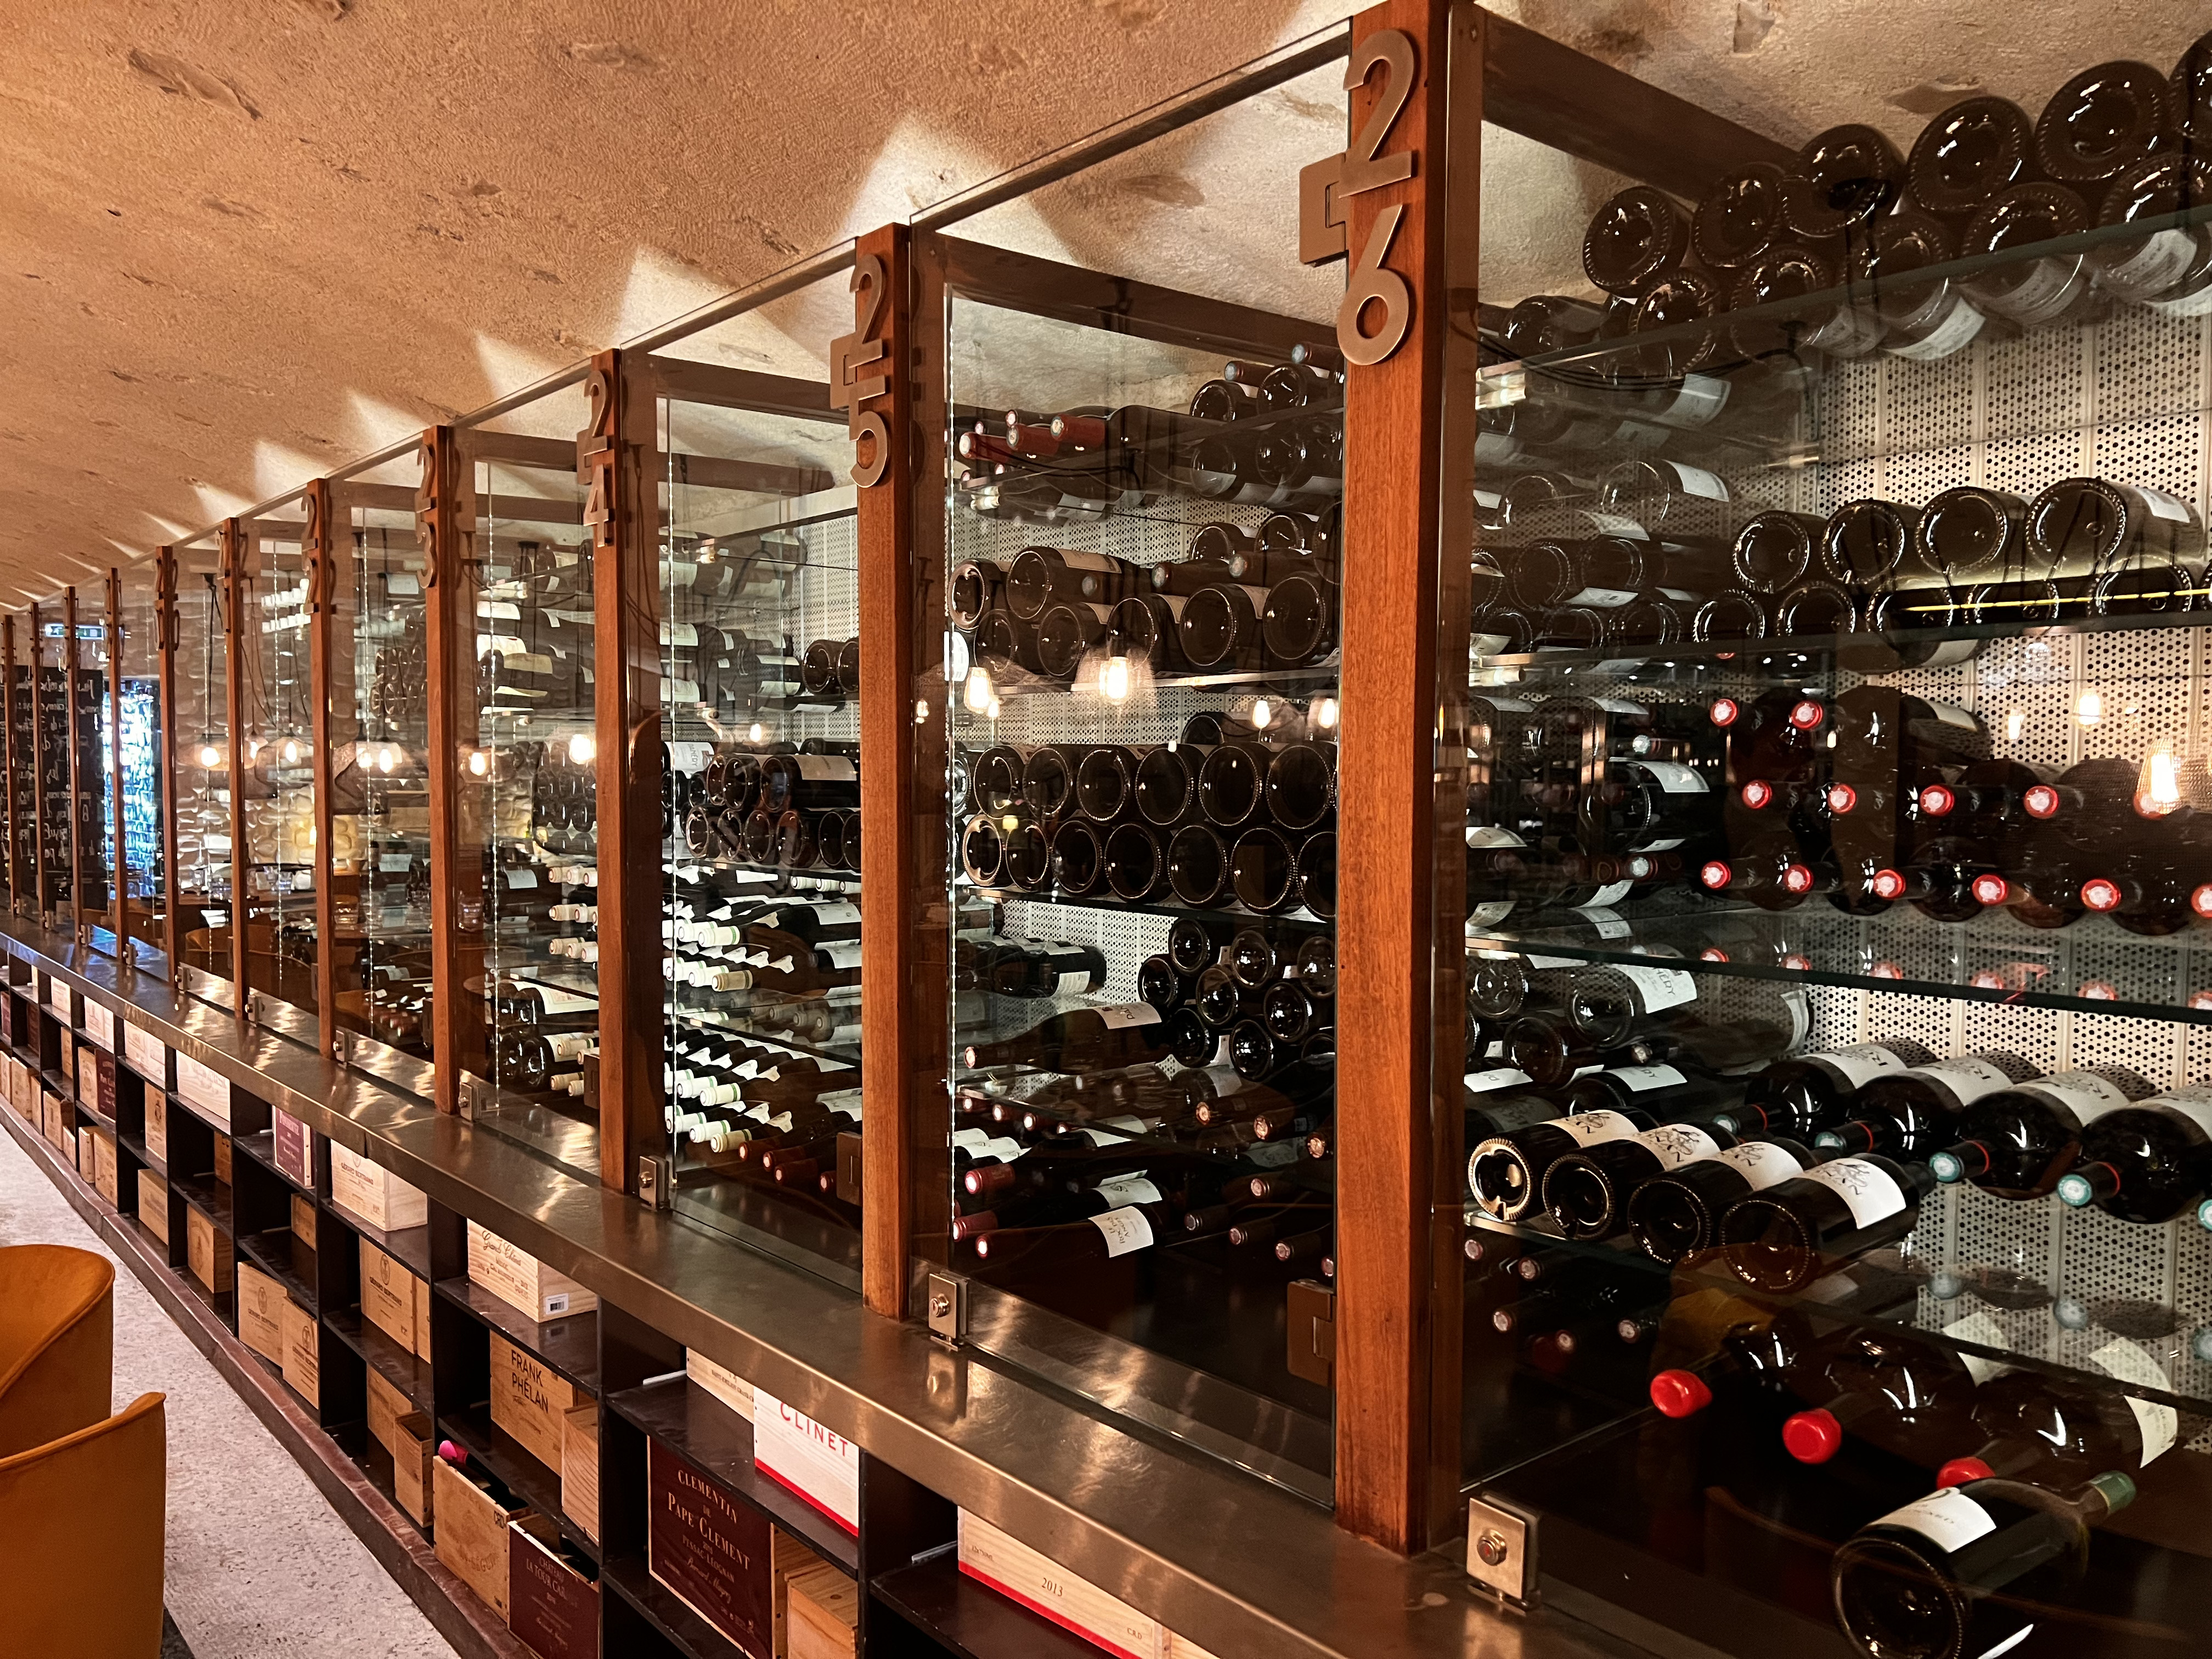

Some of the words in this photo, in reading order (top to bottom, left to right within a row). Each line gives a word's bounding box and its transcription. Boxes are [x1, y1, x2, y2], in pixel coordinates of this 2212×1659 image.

[1337, 29, 1414, 365] 26
[849, 254, 887, 488] 25
[584, 370, 609, 548] 24
[511, 1349, 543, 1387] FRANK
[512, 1372, 548, 1413] PHÉLAN
[780, 1402, 848, 1457] CLINET
[668, 1492, 694, 1528] PAPE
[678, 1470, 737, 1523] CLEMENTIN
[1041, 1577, 1063, 1598] 2013
